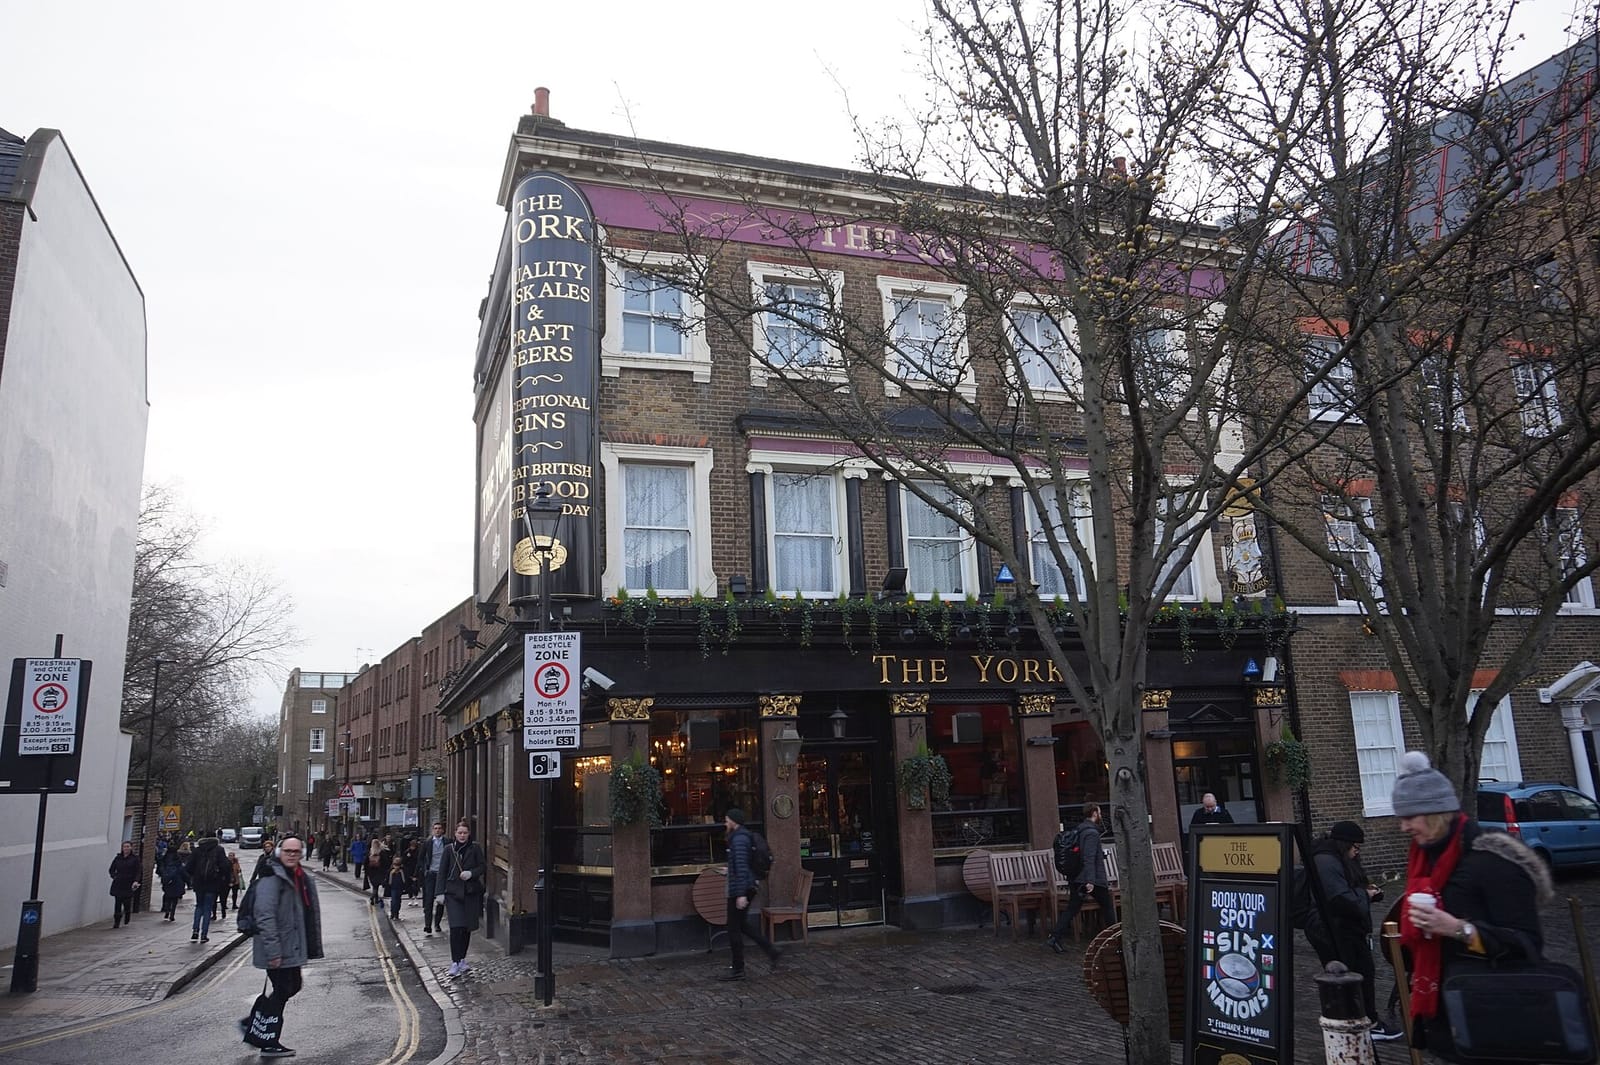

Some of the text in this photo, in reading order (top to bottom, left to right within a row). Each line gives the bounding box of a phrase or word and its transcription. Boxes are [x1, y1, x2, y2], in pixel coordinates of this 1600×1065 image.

[517, 194, 562, 216] THE
[515, 214, 585, 243] ORK
[514, 260, 587, 284] UALITY
[538, 281, 591, 302] ALES
[527, 304, 544, 321] &
[512, 345, 573, 369] BEERS
[513, 412, 565, 434] GINS
[512, 462, 592, 481] EAT BRITISH
[511, 480, 589, 505] UB FOOD
[561, 503, 590, 517] DAY
[528, 634, 577, 642] PEDESTRIAN
[535, 650, 569, 661] ZONE
[35, 674, 69, 682] ZONE
[872, 655, 949, 684] THE
[553, 728, 576, 736] permit
[1231, 842, 1247, 852] THE
[1223, 853, 1255, 866] YORK
[1212, 891, 1265, 912] BOOK YOUR
[1220, 908, 1256, 928] SPOT
[1217, 931, 1259, 960] SIX
[1206, 980, 1268, 1019] NATIONS
